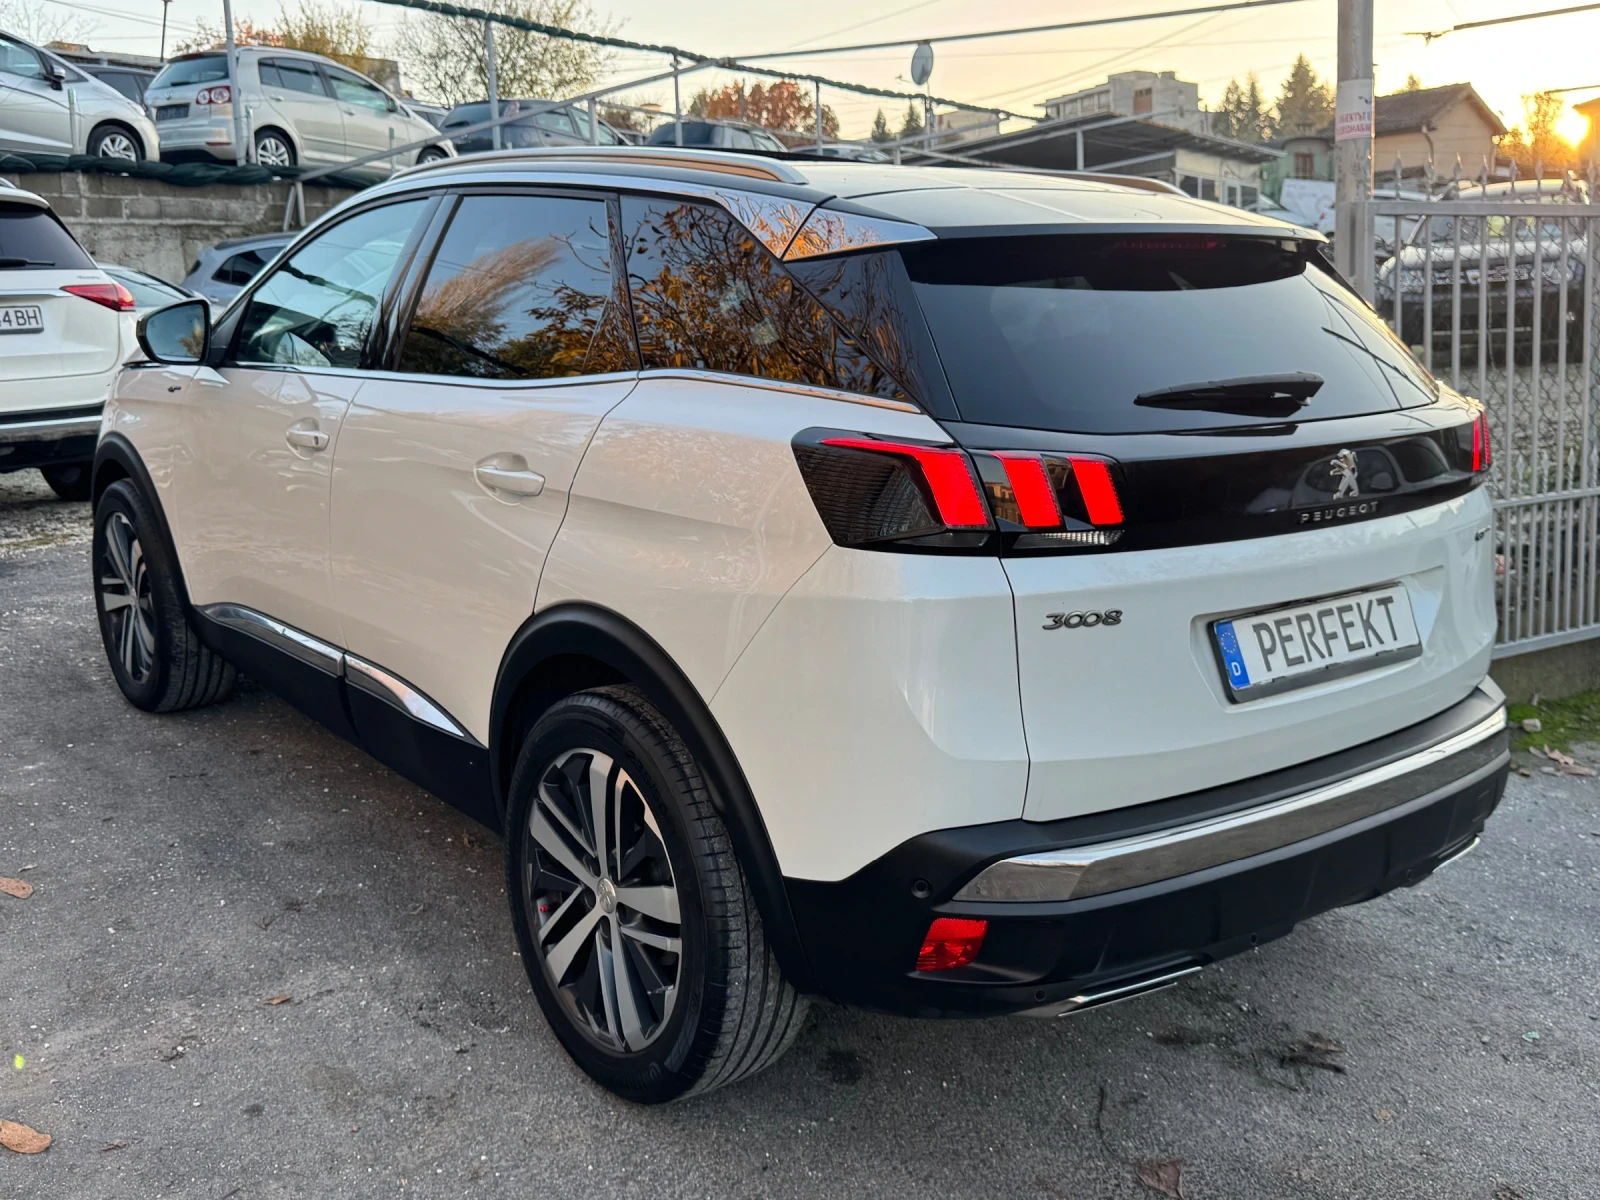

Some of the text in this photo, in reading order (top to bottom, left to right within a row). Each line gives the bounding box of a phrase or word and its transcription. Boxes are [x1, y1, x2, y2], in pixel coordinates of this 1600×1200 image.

[1301, 501, 1379, 524] PEUGEOT
[1042, 608, 1123, 630] 3008
[1252, 595, 1398, 672] PERFEKT
[1231, 661, 1242, 677] D
